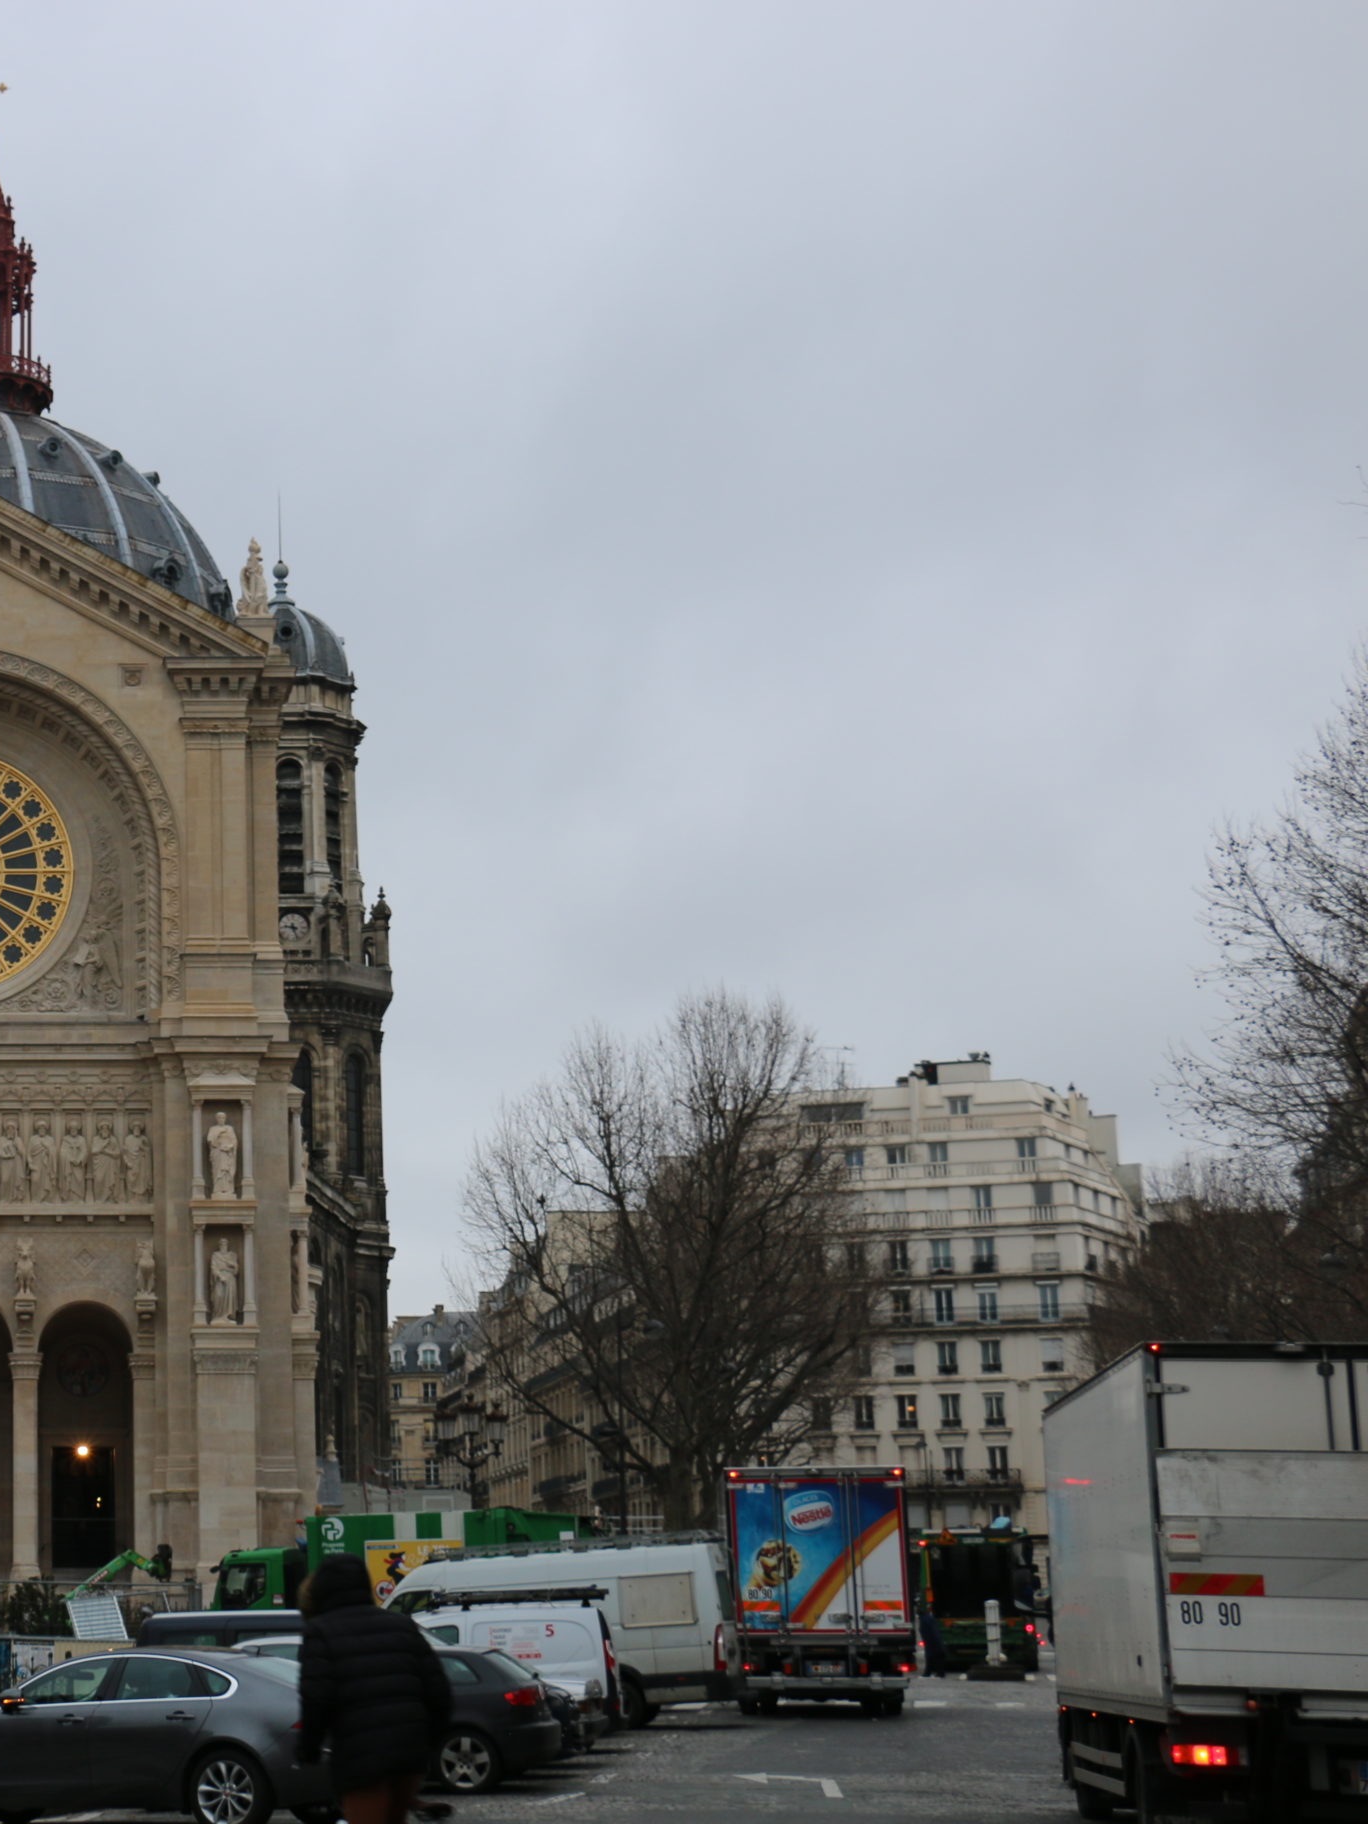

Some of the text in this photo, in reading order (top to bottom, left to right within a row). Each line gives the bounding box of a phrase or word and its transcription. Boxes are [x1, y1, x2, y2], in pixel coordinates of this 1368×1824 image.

[791, 1505, 832, 1526] Nestlé
[748, 1588, 773, 1599] 80 90
[1180, 1600, 1241, 1626] 80 90
[545, 1624, 554, 1637] 5
